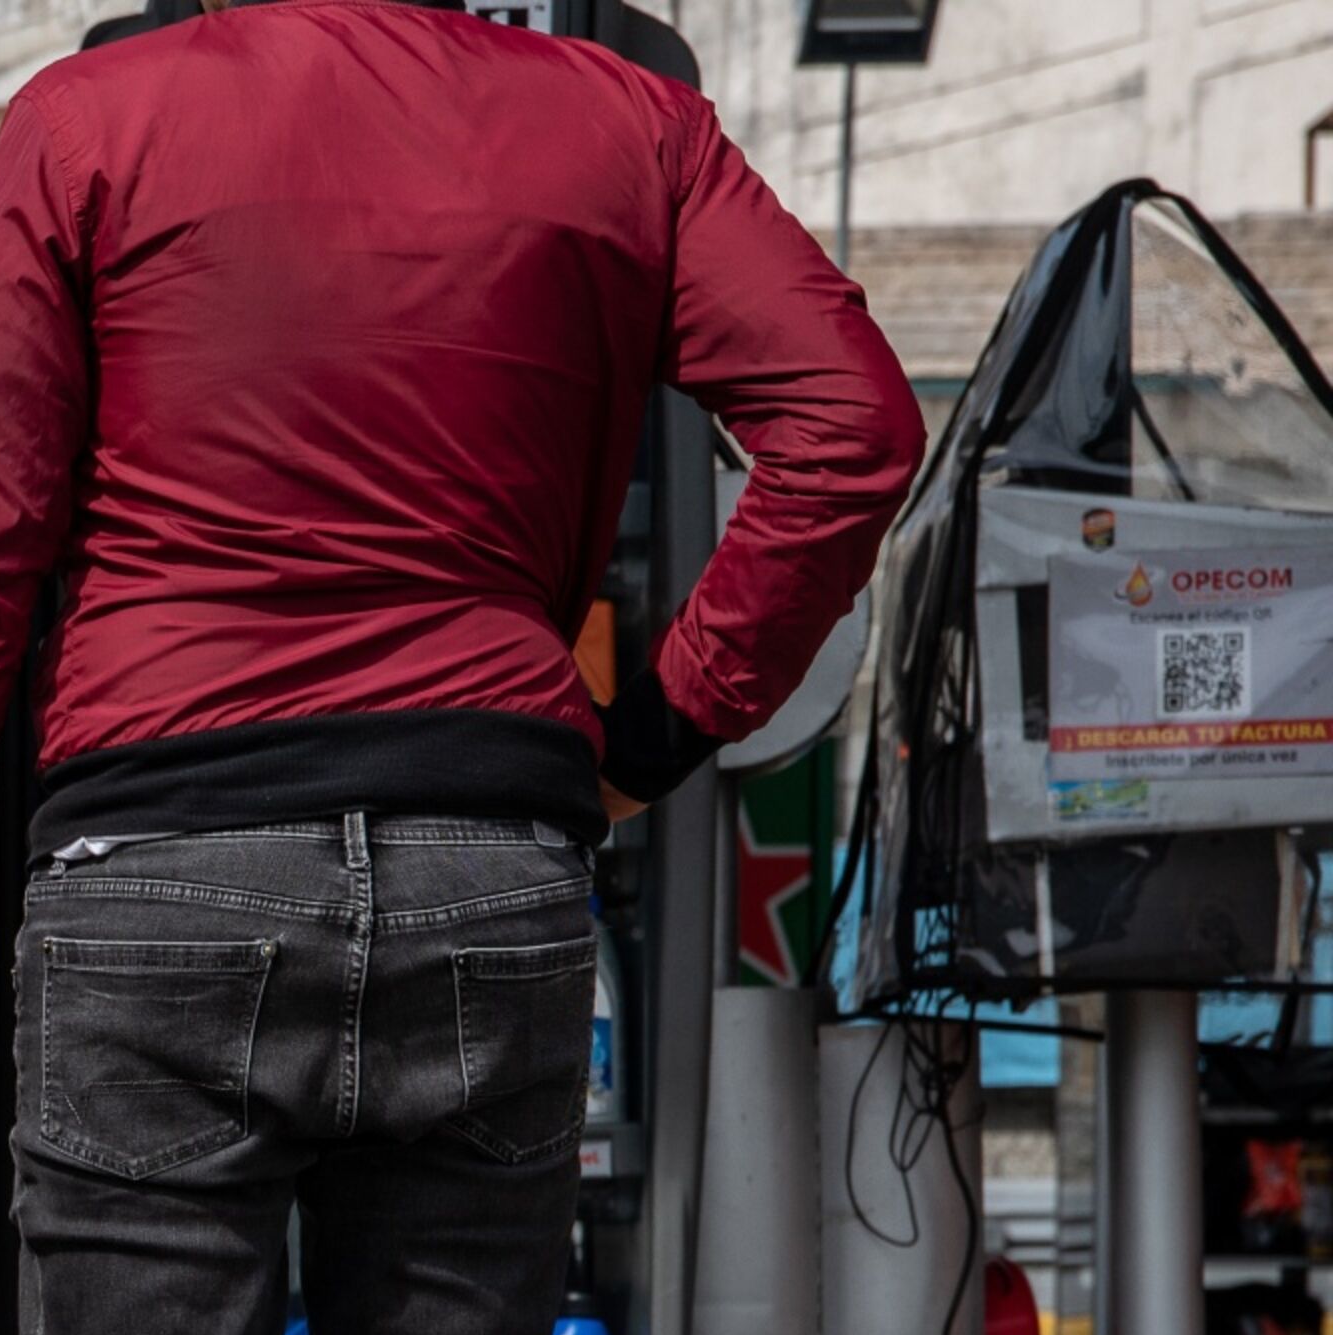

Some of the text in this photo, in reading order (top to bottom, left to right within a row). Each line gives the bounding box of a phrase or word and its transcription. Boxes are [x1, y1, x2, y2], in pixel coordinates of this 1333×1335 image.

[1171, 567, 1294, 593] OPECOM
[1077, 725, 1190, 747] DESCARGA
[1196, 725, 1225, 742] TU
[1231, 721, 1327, 741] FACTURA
